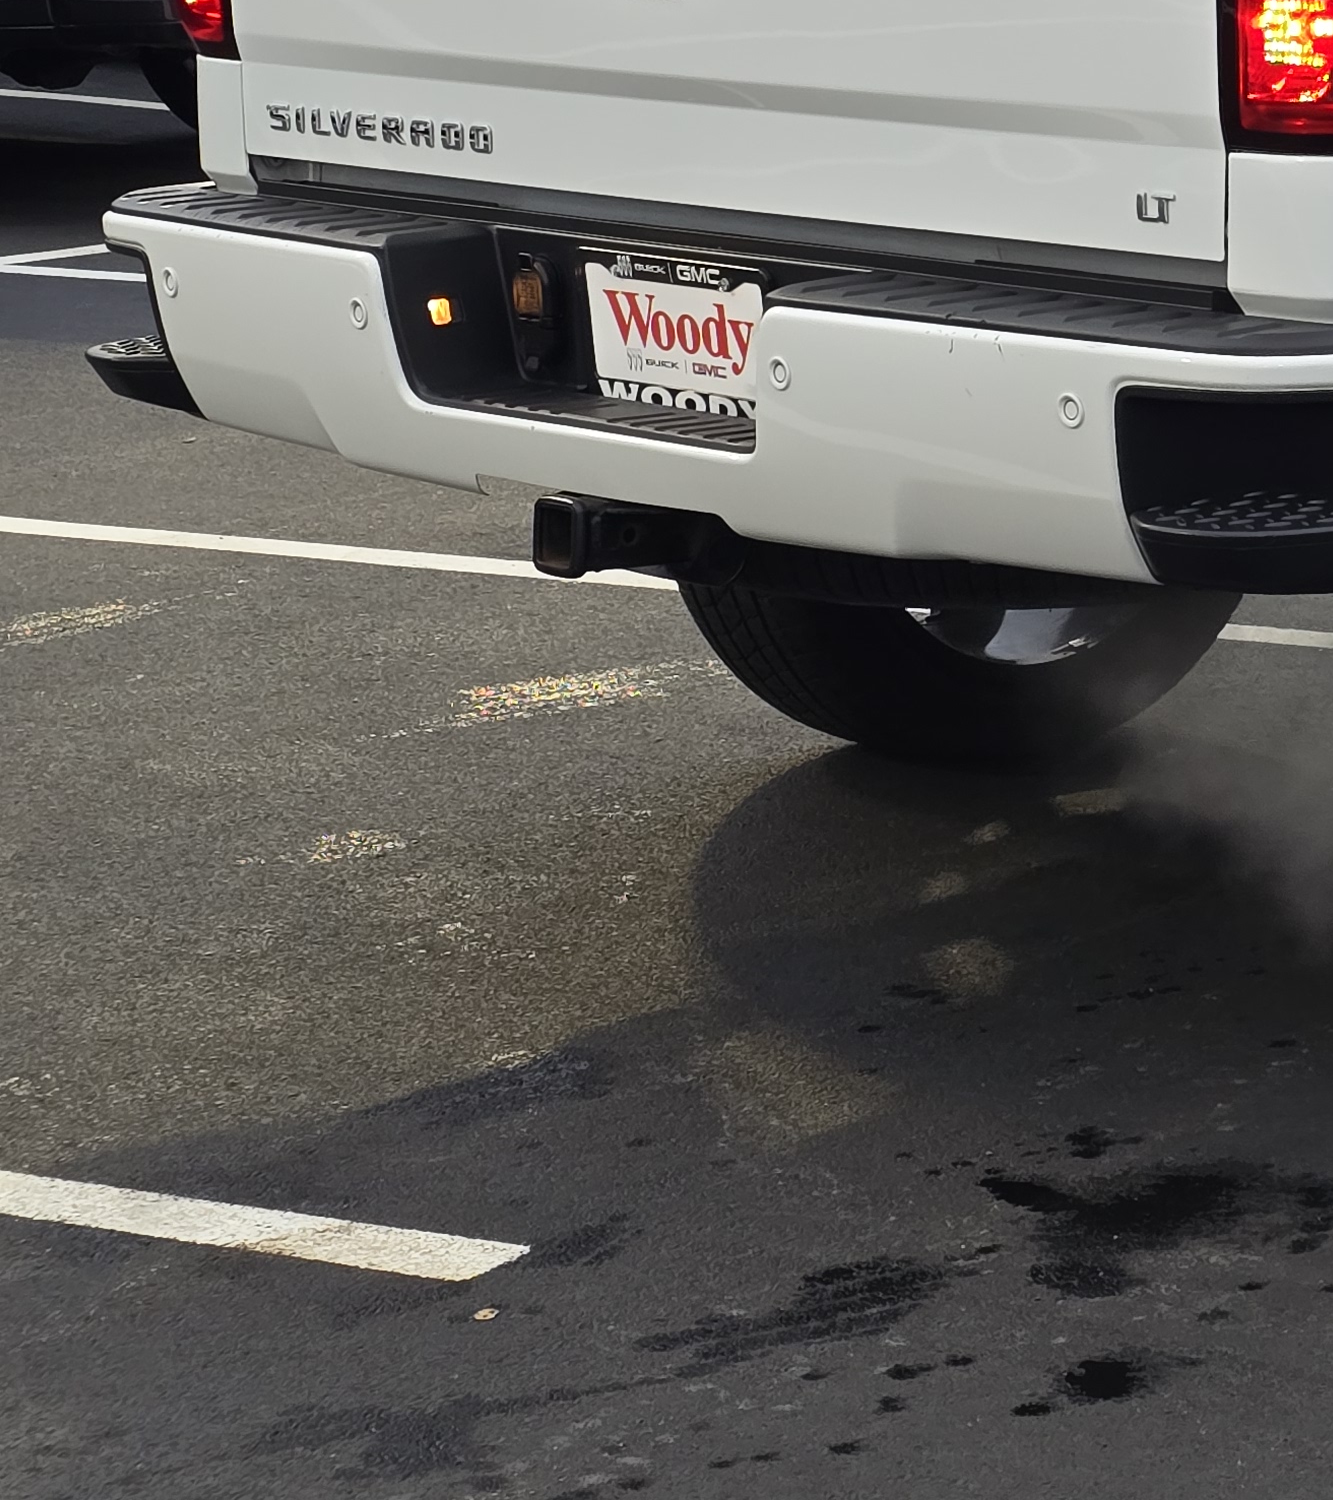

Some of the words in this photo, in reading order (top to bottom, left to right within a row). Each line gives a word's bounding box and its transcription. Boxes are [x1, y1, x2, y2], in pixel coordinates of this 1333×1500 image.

[266, 103, 494, 155] SILVERADO
[1136, 191, 1176, 224] LT
[634, 263, 666, 275] BUICK
[676, 264, 720, 285] GMC
[603, 289, 754, 375] Woody
[645, 359, 679, 370] BUICK
[692, 362, 728, 379] GMC
